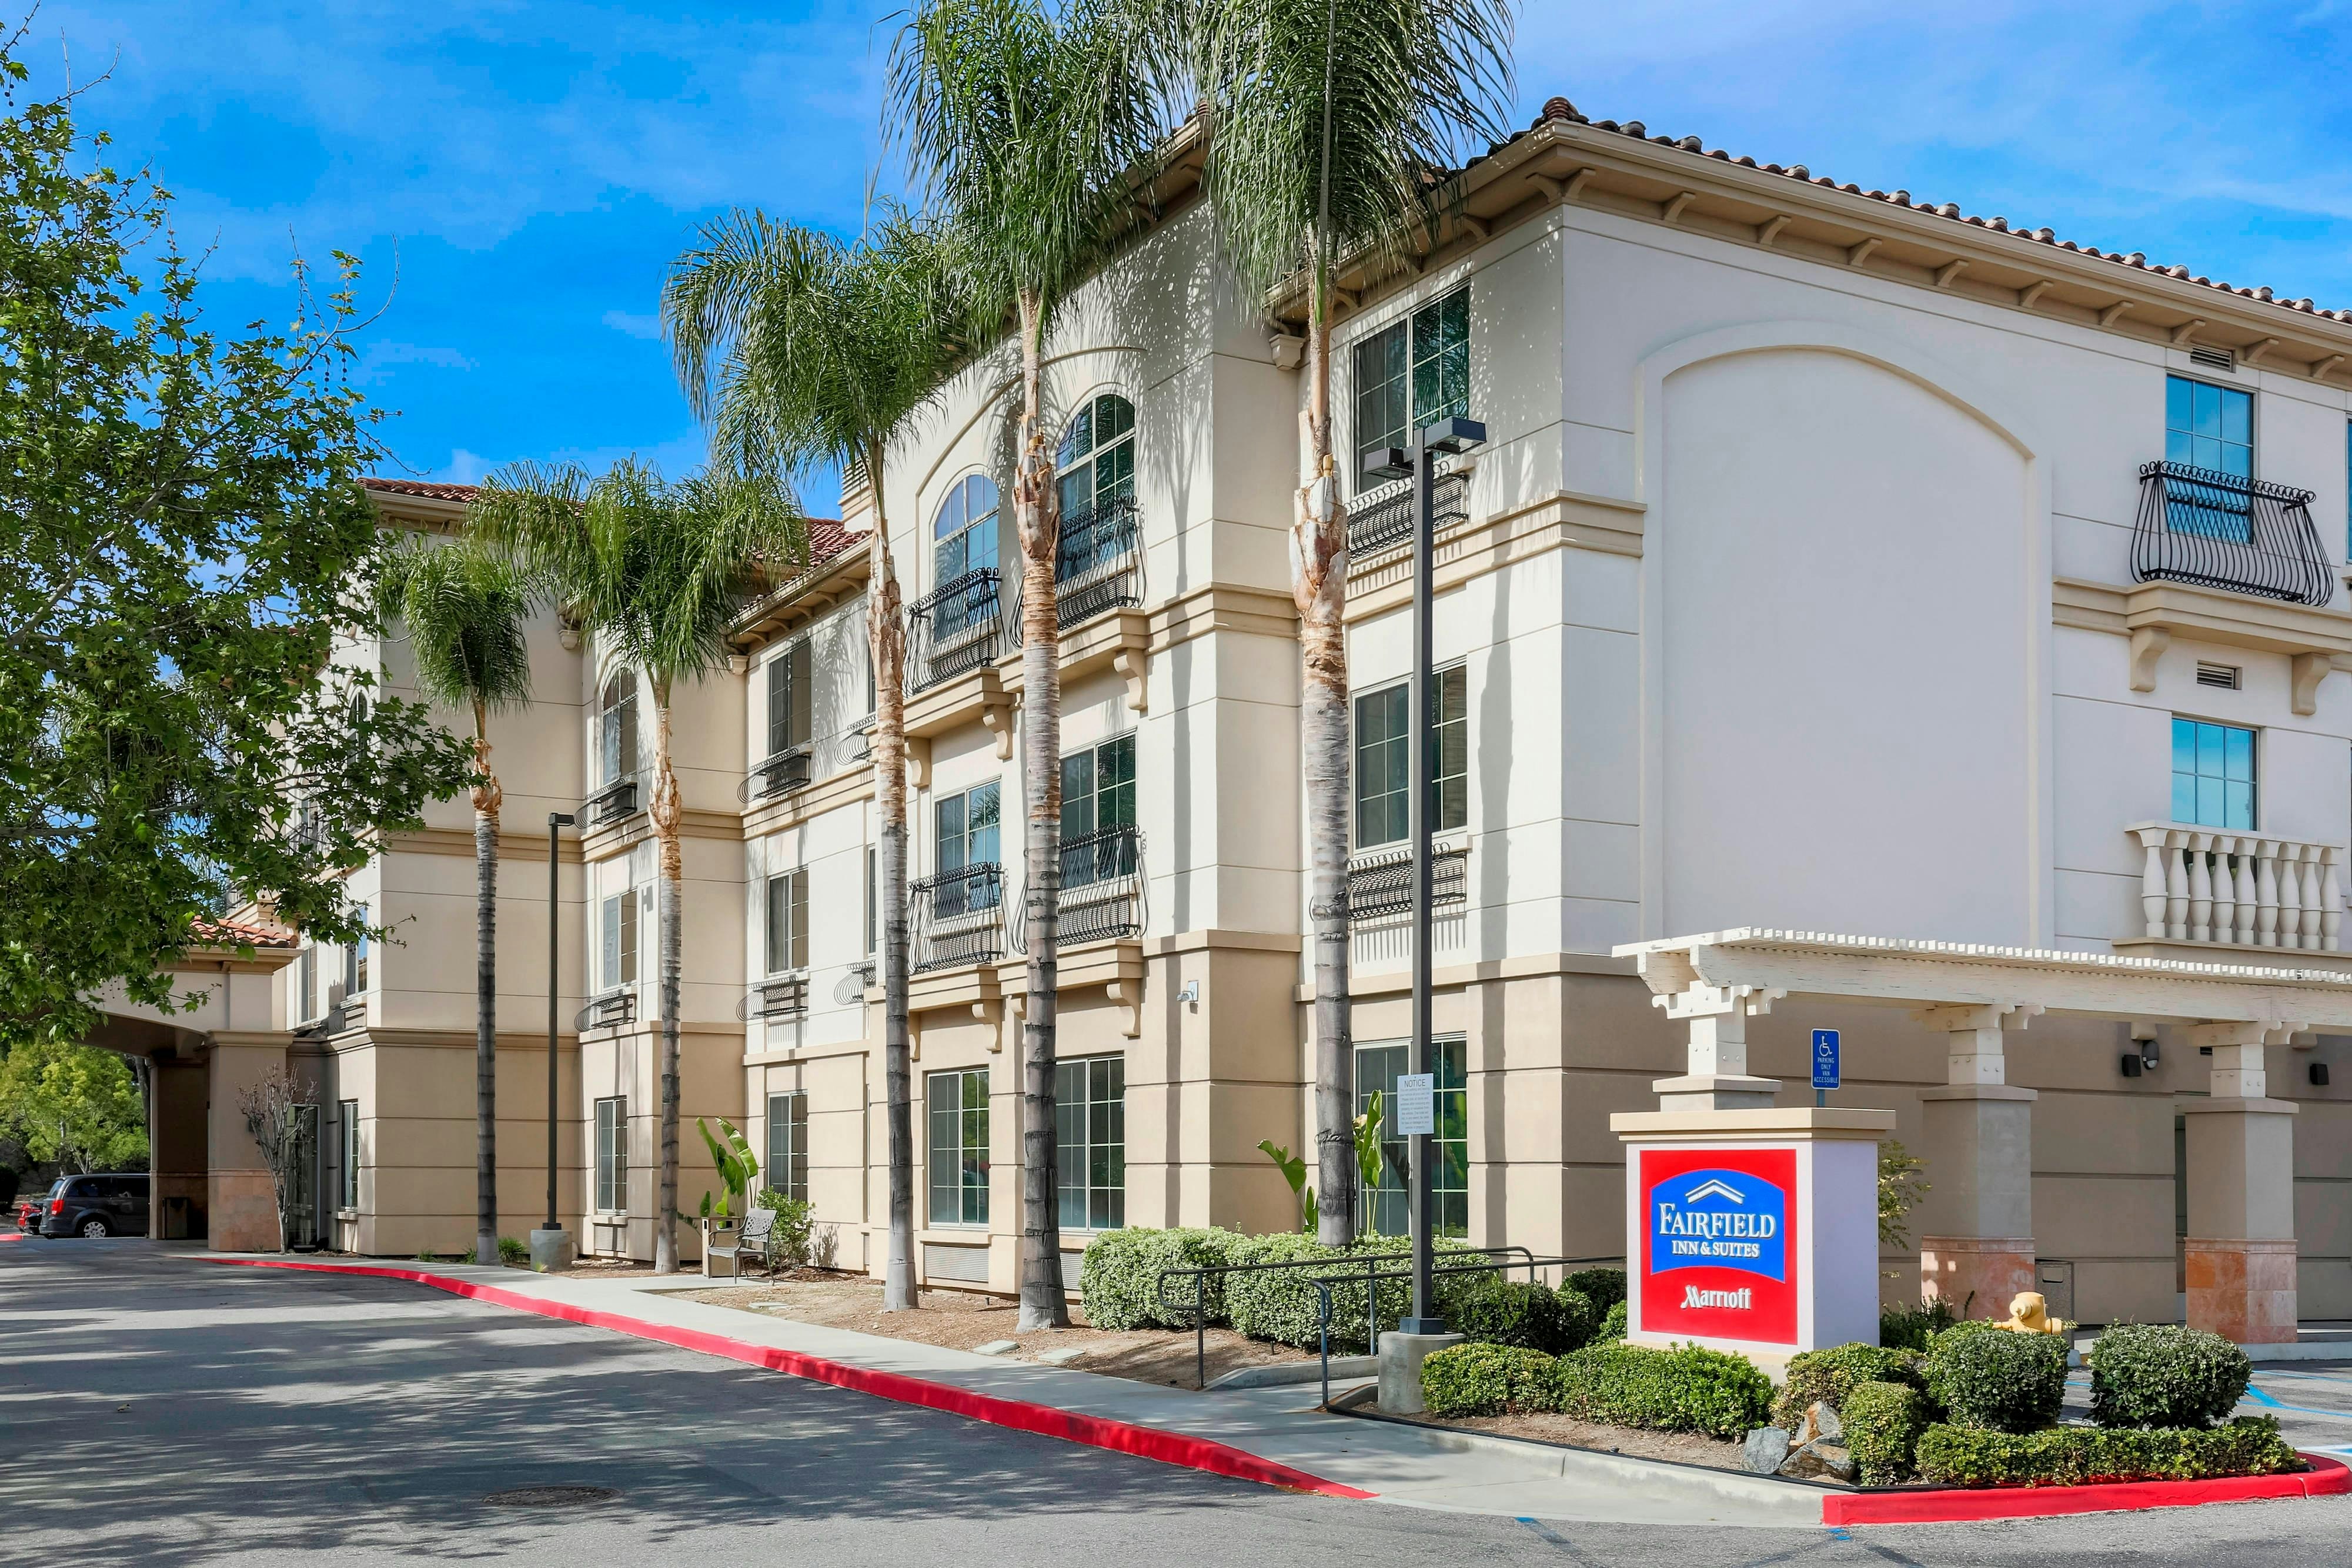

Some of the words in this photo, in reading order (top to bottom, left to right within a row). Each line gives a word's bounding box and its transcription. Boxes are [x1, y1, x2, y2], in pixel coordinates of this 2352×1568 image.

[1404, 1079, 1426, 1088] NOTICE
[1659, 1203, 1776, 1239] FAIRFIELD
[1672, 1241, 1698, 1255] INN
[1700, 1242, 1712, 1256] &
[1712, 1242, 1760, 1258] SUITES
[1681, 1285, 1752, 1309] Marriott
